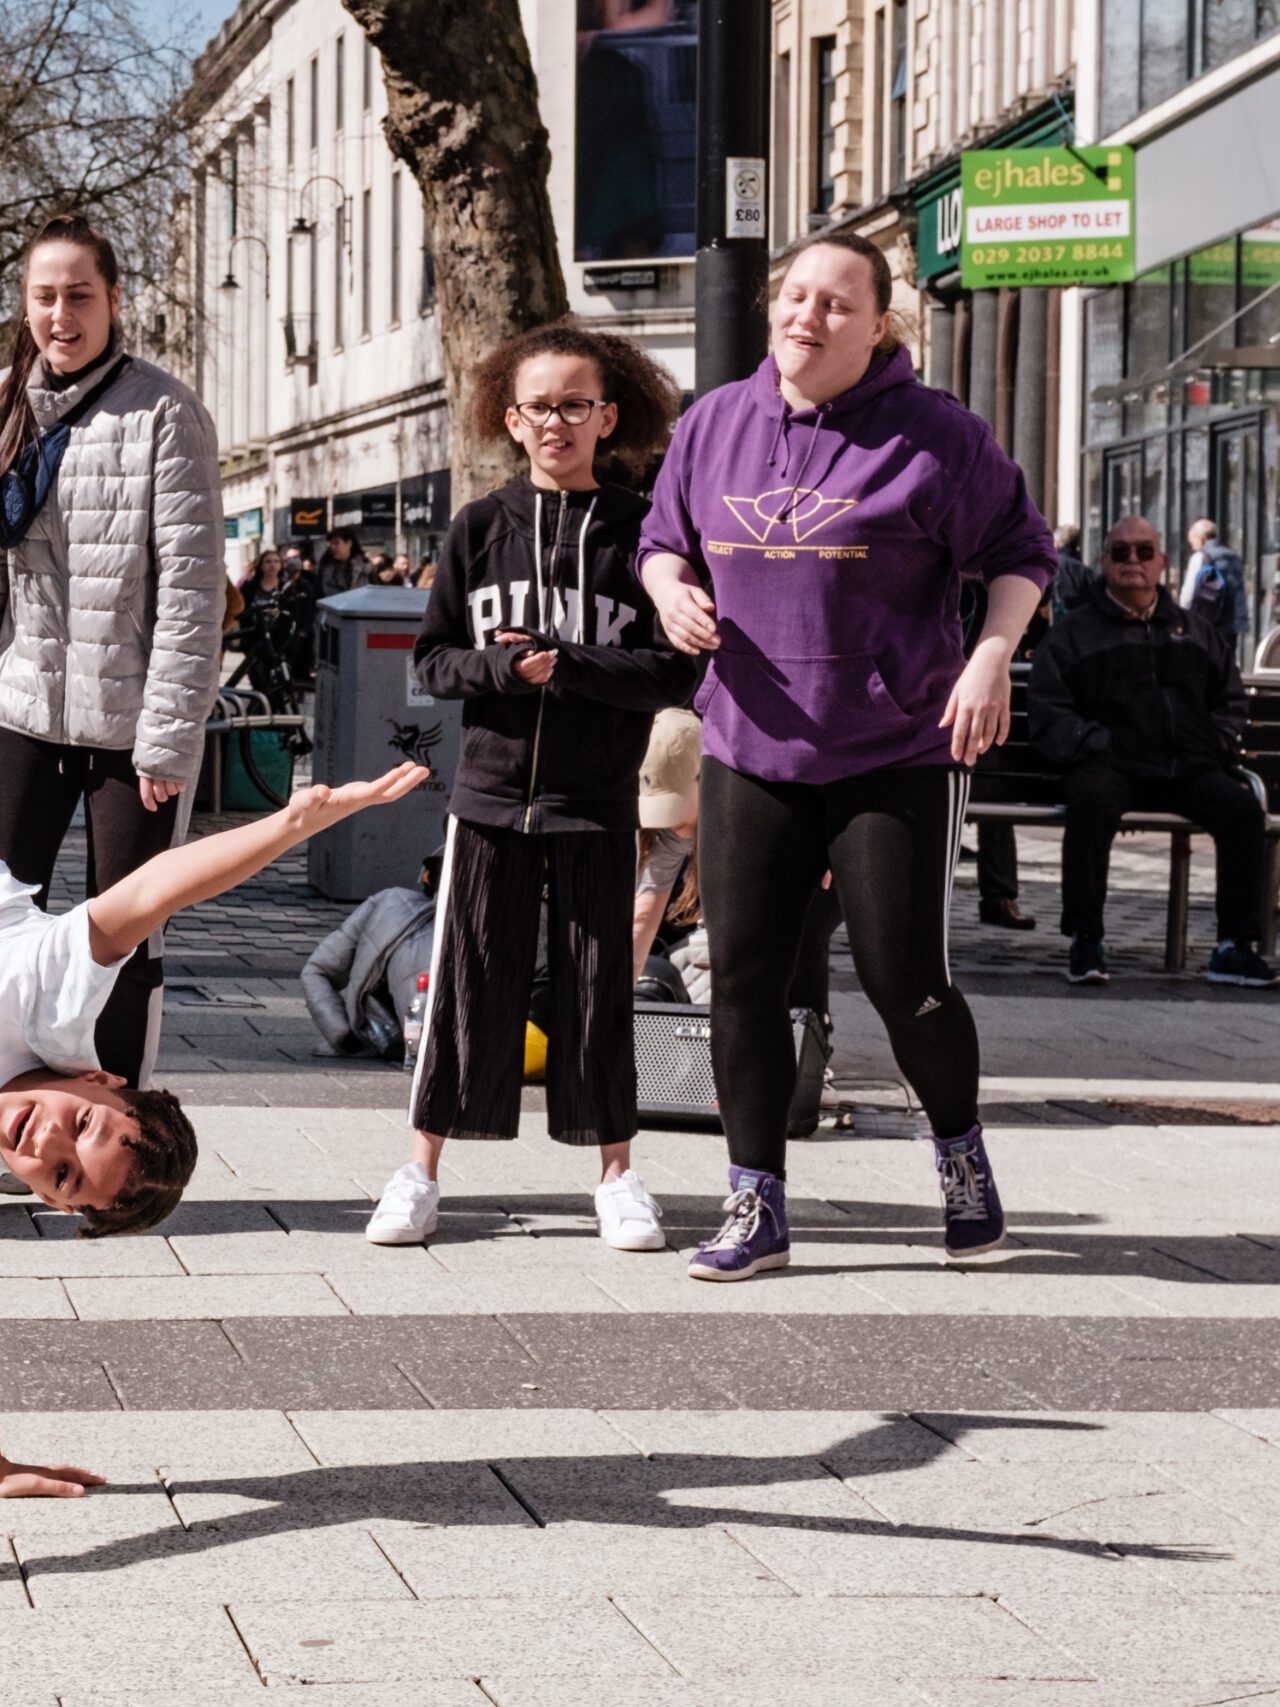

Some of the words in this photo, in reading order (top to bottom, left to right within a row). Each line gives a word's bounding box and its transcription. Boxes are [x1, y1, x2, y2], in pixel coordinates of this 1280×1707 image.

[974, 156, 1086, 199] ejhales
[735, 209, 760, 222] £80
[936, 187, 962, 255] LLO
[976, 217, 1022, 232] LARGE
[1028, 214, 1066, 230] SHOP
[1073, 213, 1091, 228] TO
[1096, 212, 1123, 227] LET
[972, 248, 1010, 265] 029
[1016, 245, 1066, 263] 2037
[1072, 243, 1123, 261] 8844
[985, 267, 1110, 282] www.ejhales.co.uk
[764, 550, 796, 559] ACTION
[819, 550, 868, 559] POTENTIAL
[468, 580, 637, 650] PINK
